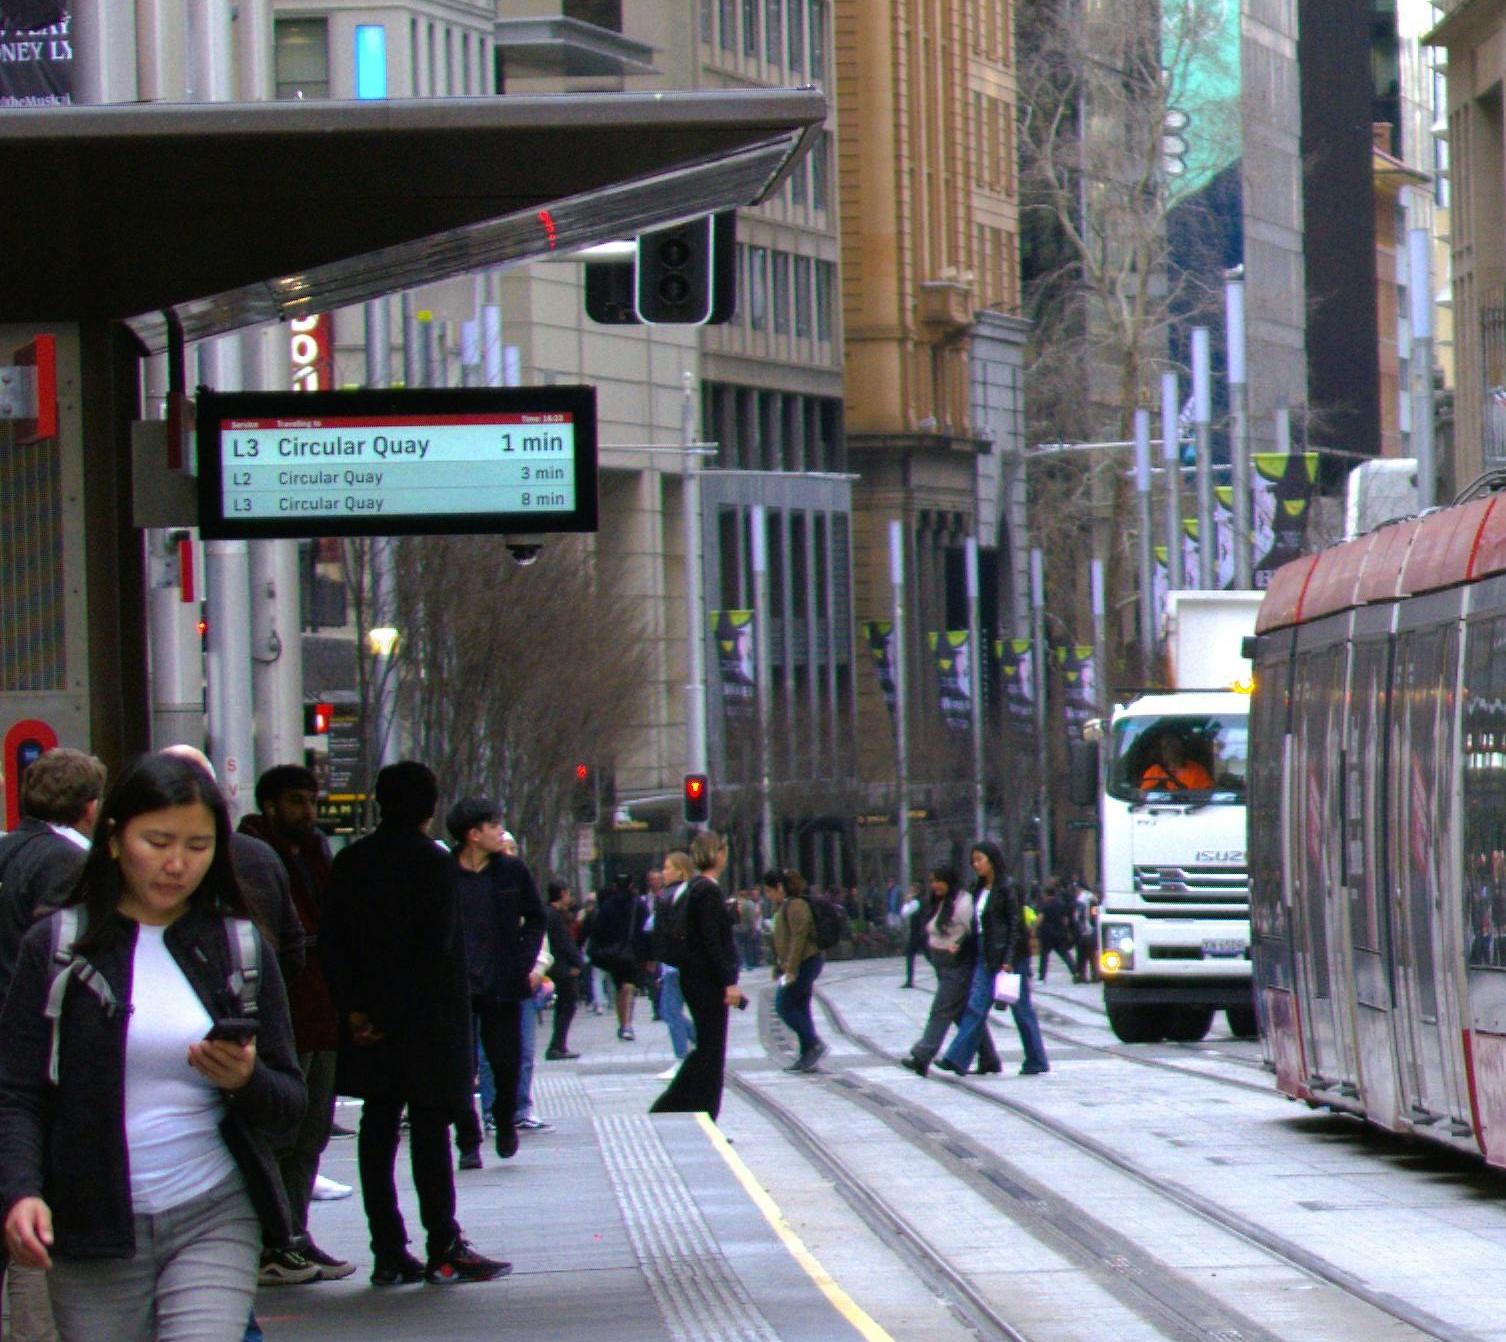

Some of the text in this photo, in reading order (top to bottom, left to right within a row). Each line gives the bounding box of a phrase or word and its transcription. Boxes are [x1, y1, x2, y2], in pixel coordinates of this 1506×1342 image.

[233, 431, 563, 459] L3 Circular Quay 1 min
[233, 465, 565, 487] L2 Circular Quay 3 min
[233, 491, 565, 512] L3 Circular Quay 8 min
[1195, 850, 1246, 862] ISUZ
